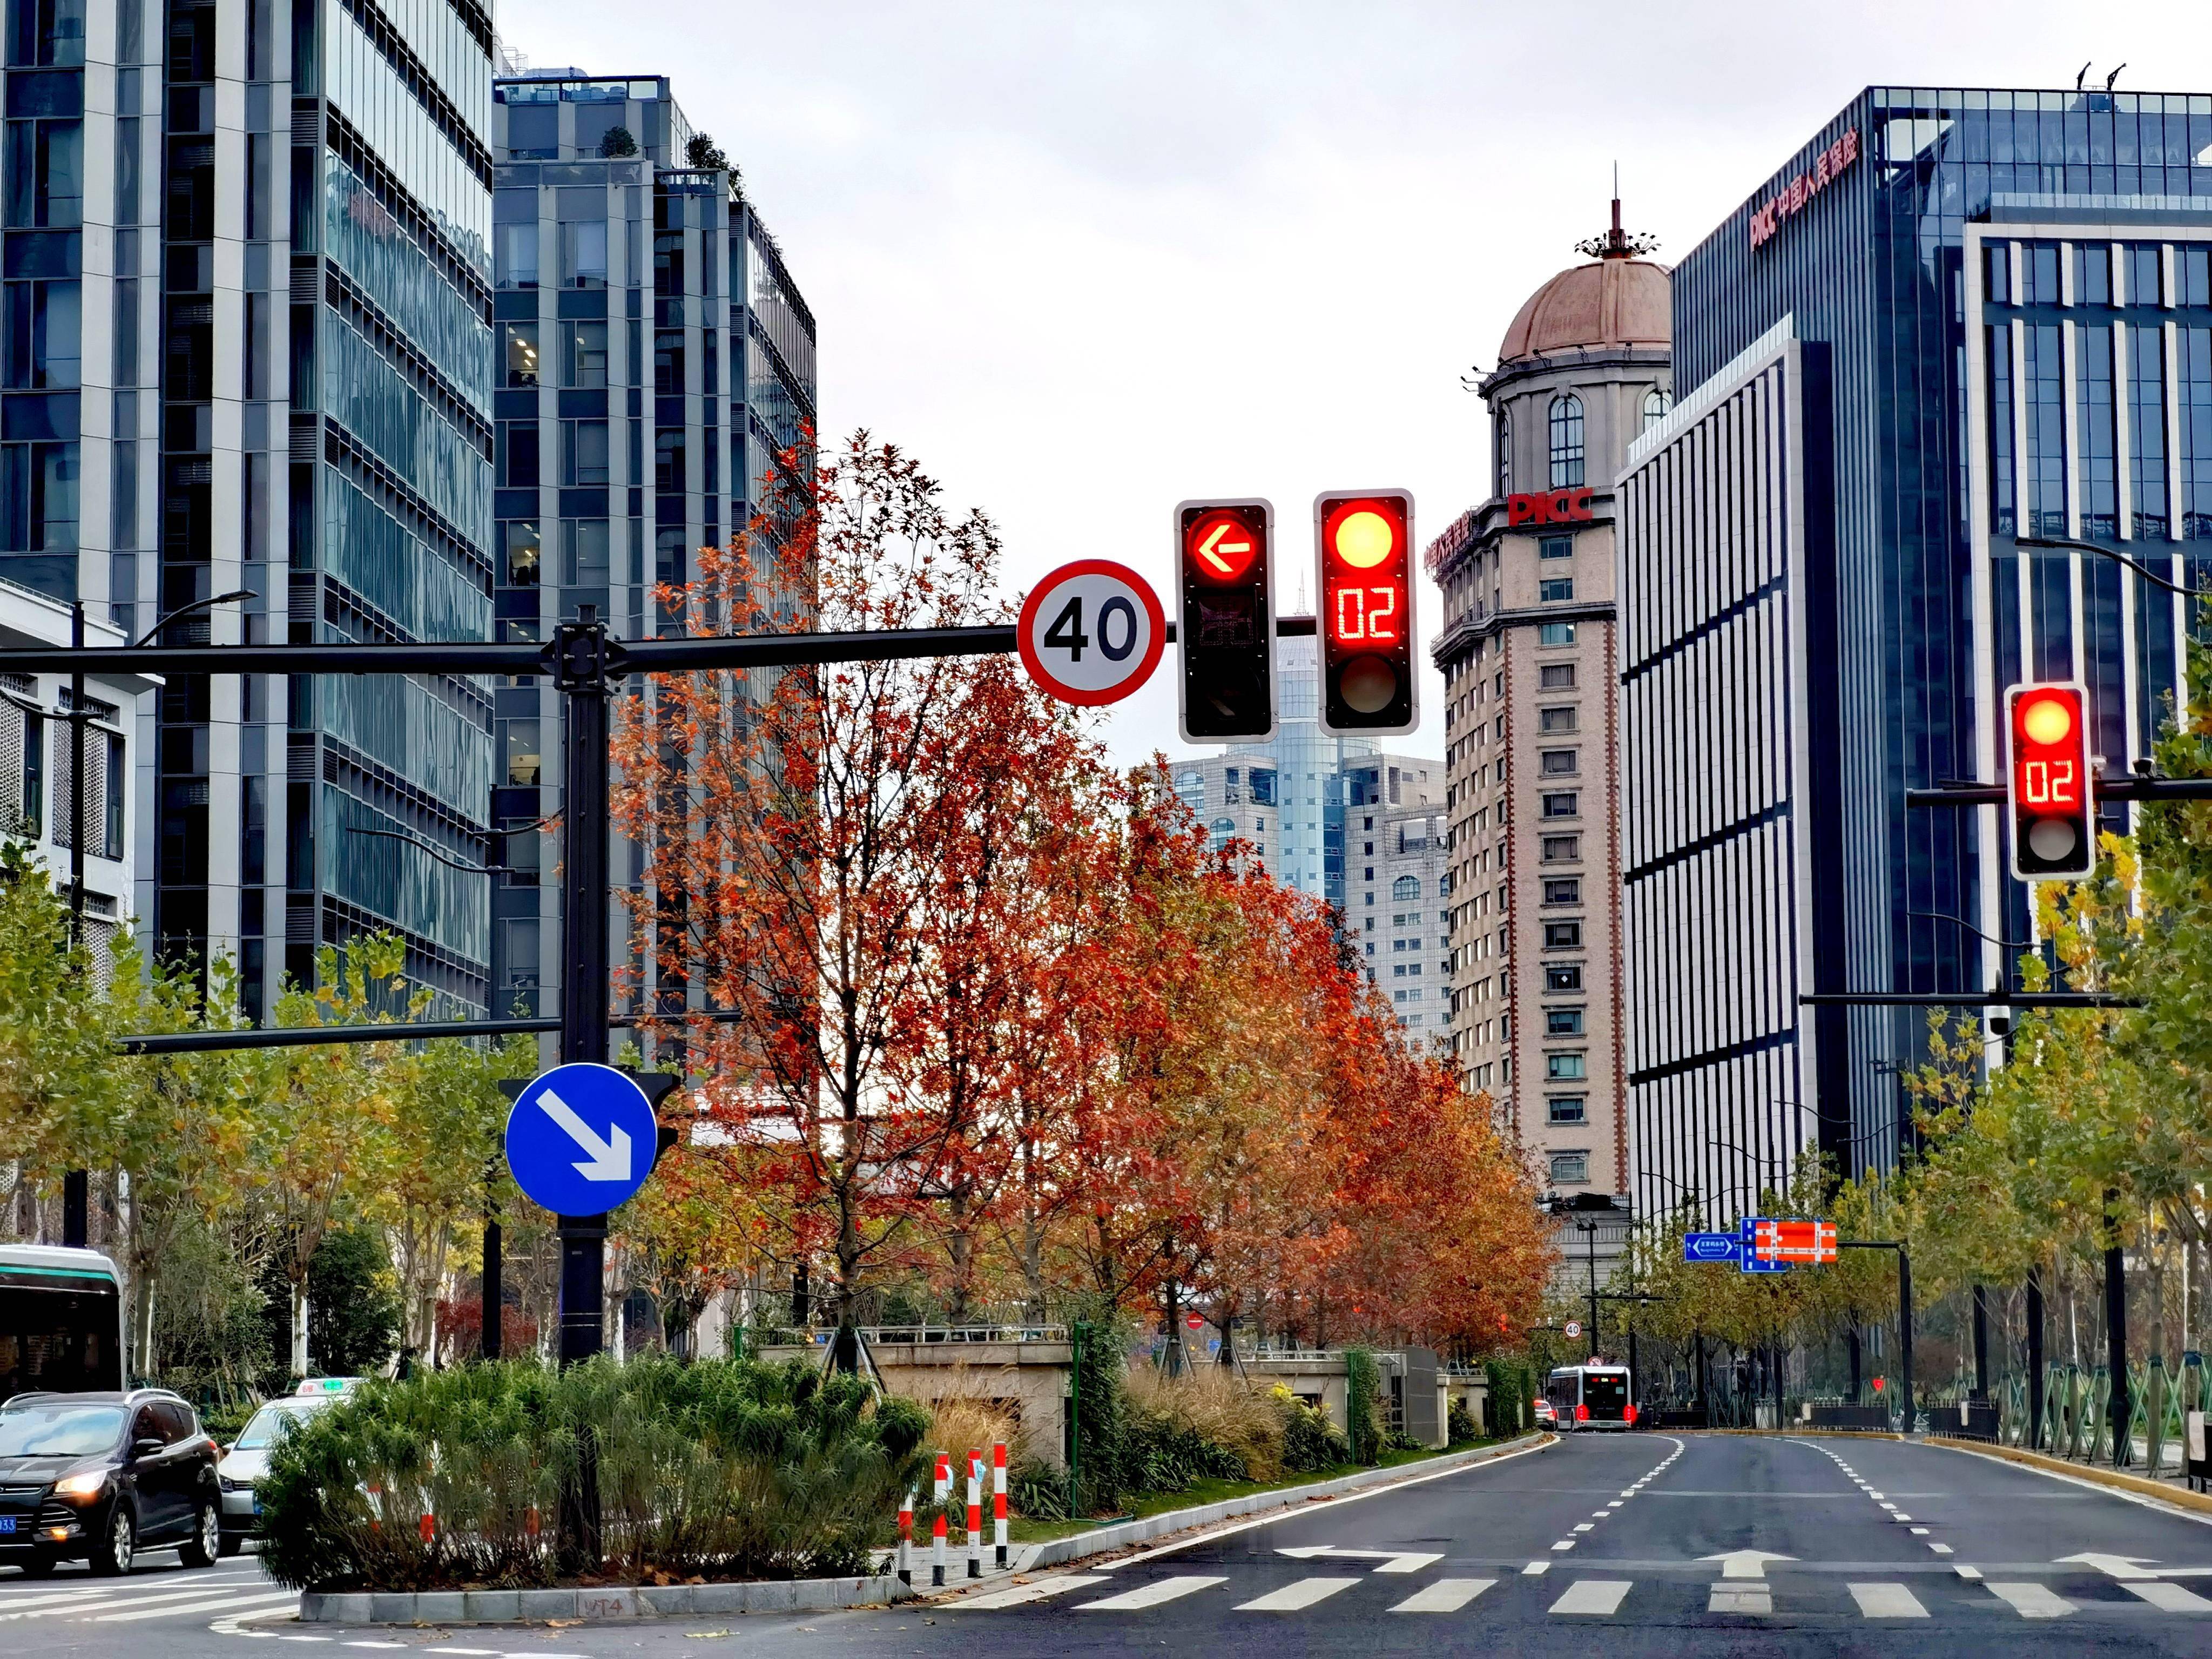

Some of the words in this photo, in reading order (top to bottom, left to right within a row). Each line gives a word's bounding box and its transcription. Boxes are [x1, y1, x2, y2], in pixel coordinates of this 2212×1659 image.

[1750, 197, 1777, 253] PICC
[1778, 126, 1858, 224] 中国人民保险
[1508, 488, 1594, 527] PICC
[1043, 595, 1137, 662] 40
[1337, 586, 1395, 639] 02
[2026, 760, 2074, 803] 02
[1567, 1326, 1579, 1334] 40
